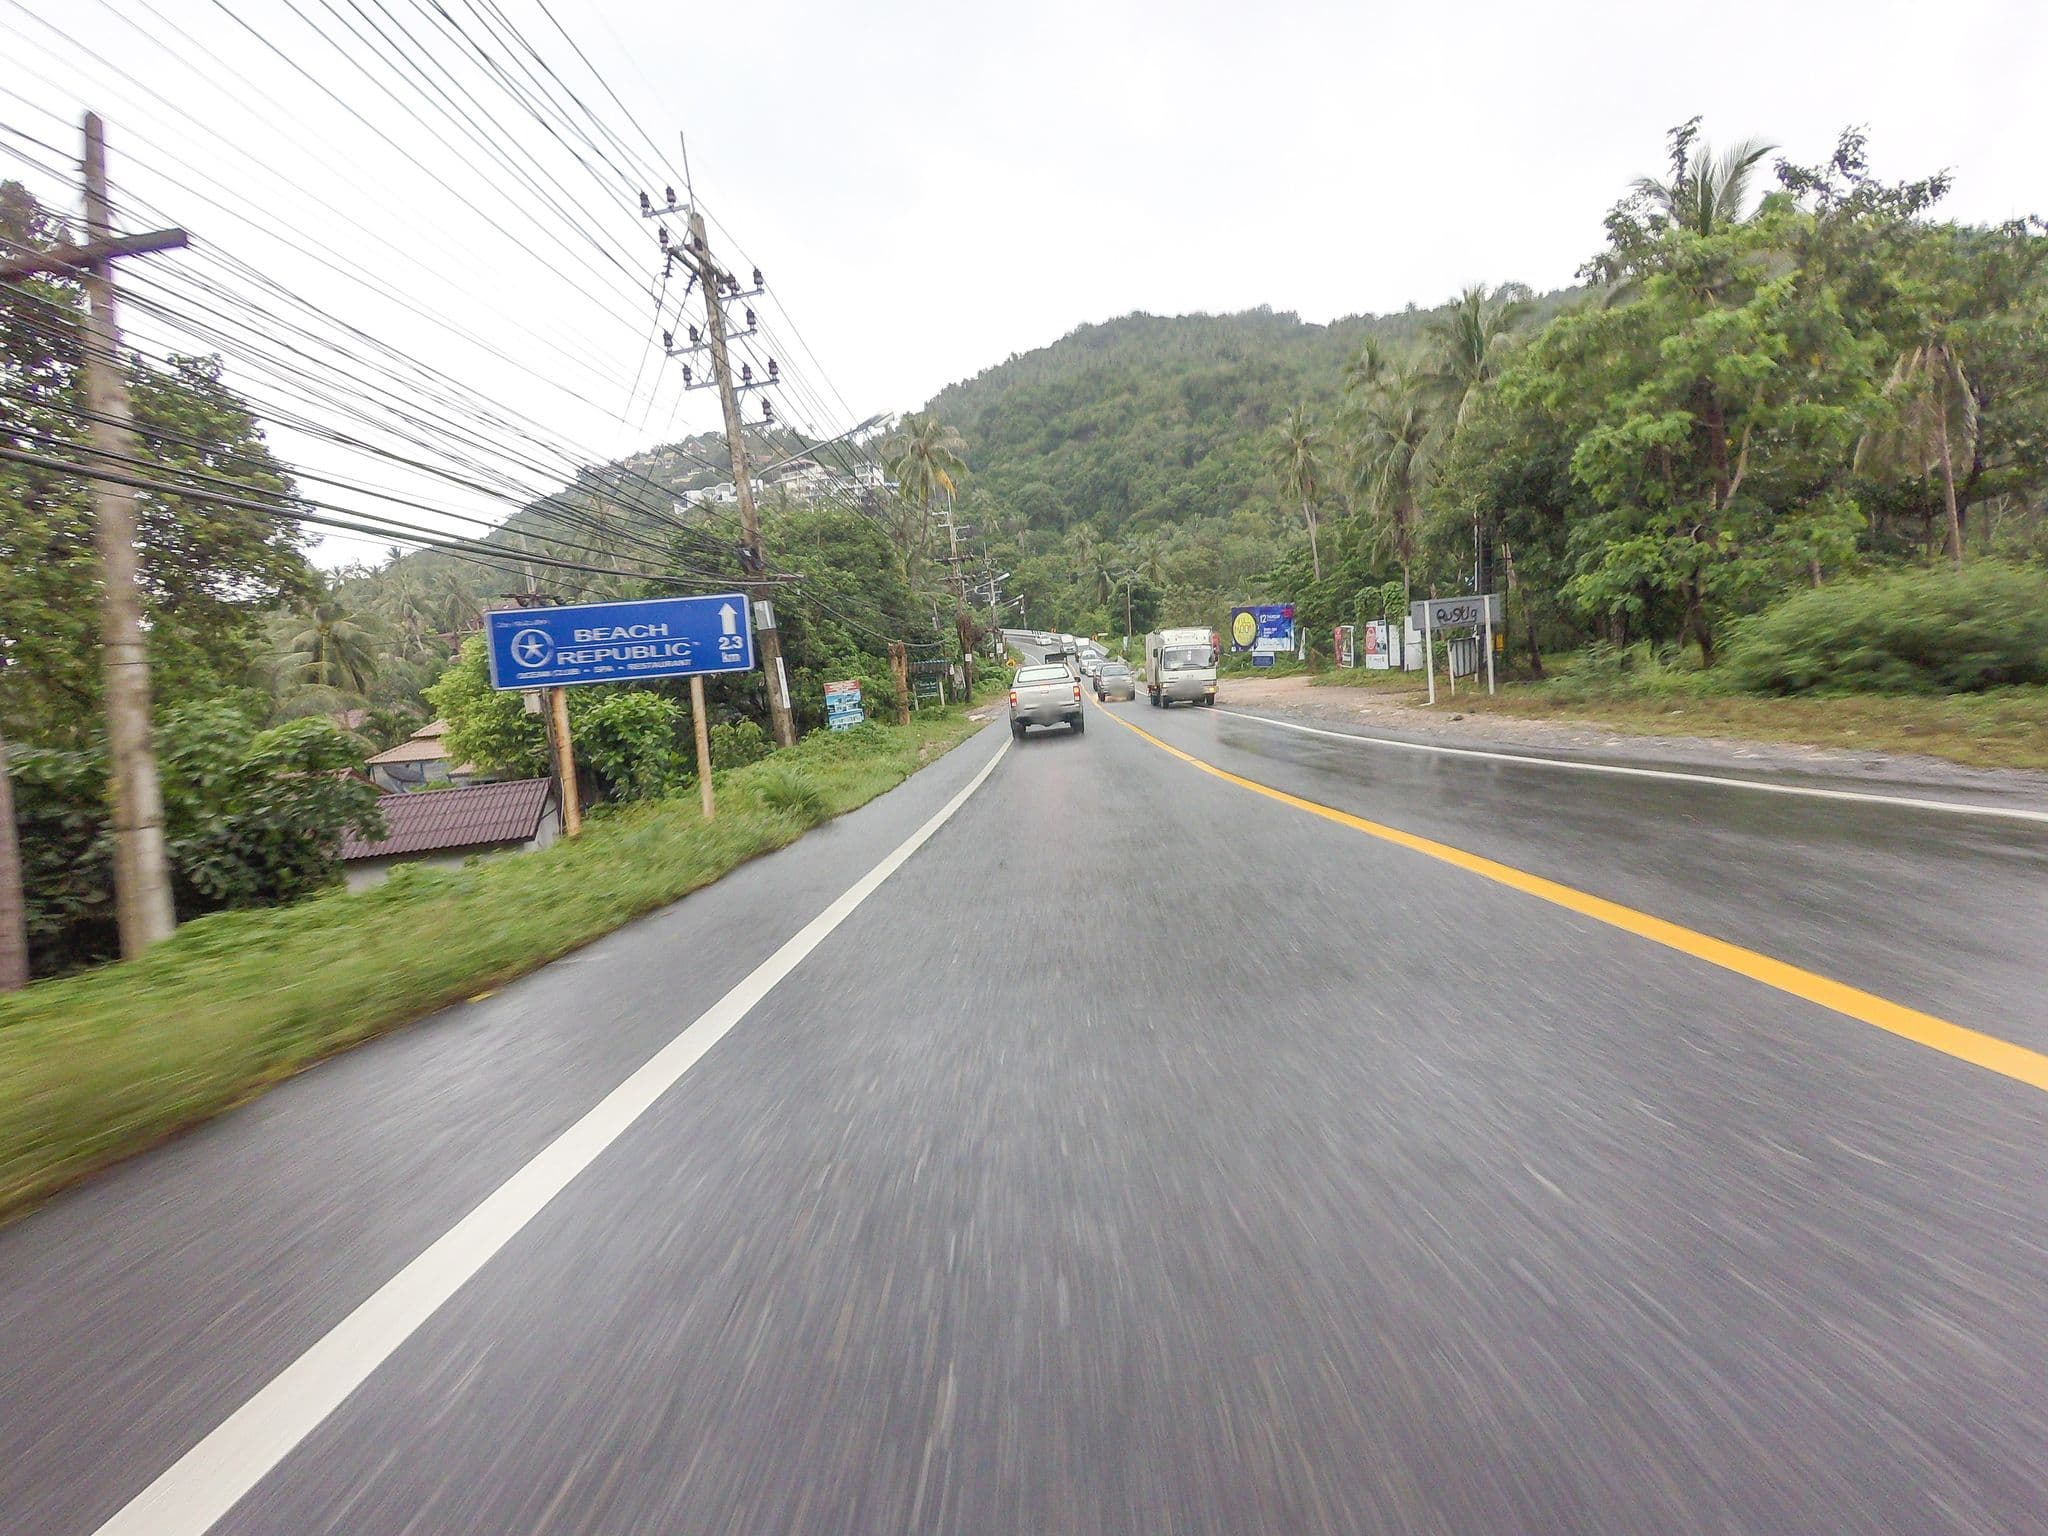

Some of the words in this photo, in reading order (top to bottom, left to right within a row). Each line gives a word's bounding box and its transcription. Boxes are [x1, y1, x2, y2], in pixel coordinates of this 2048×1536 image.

[574, 623, 668, 642] BEACH
[557, 643, 692, 665] REPUBLIC
[593, 665, 614, 673] SPA
[626, 659, 692, 670] RESTAURANT
